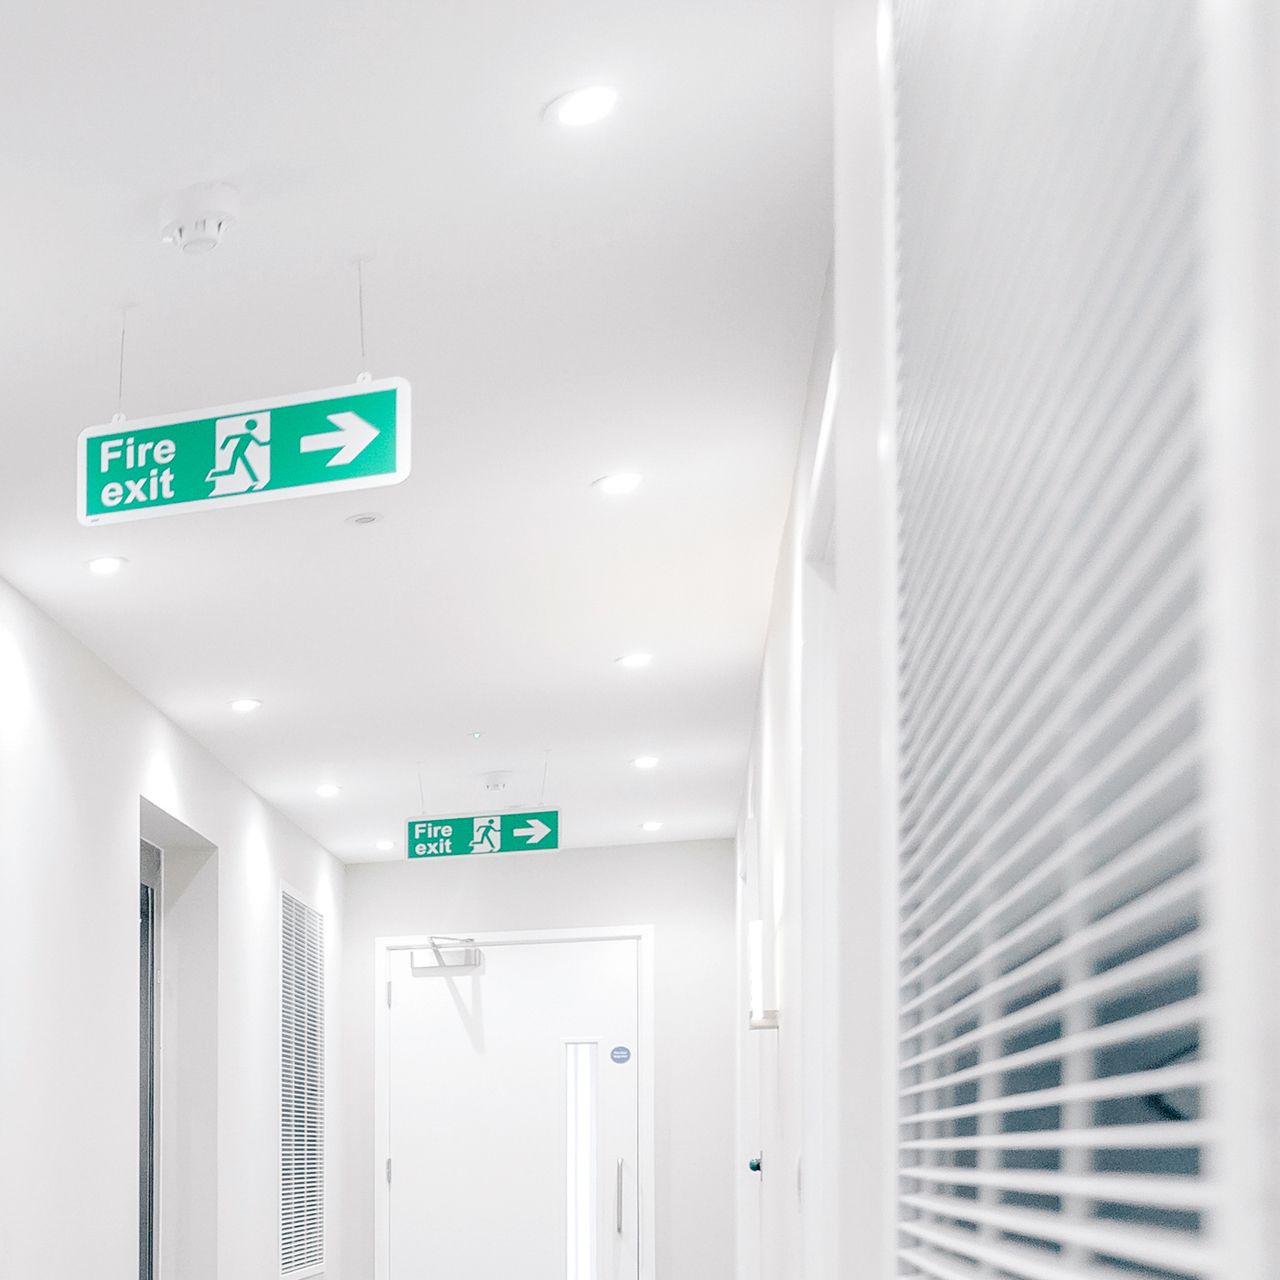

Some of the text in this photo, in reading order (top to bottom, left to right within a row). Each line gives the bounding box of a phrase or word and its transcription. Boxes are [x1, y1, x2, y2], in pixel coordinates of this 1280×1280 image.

[100, 437, 176, 473] Fire
[101, 468, 175, 506] exit
[415, 823, 453, 839] Fire
[415, 839, 452, 855] exit
